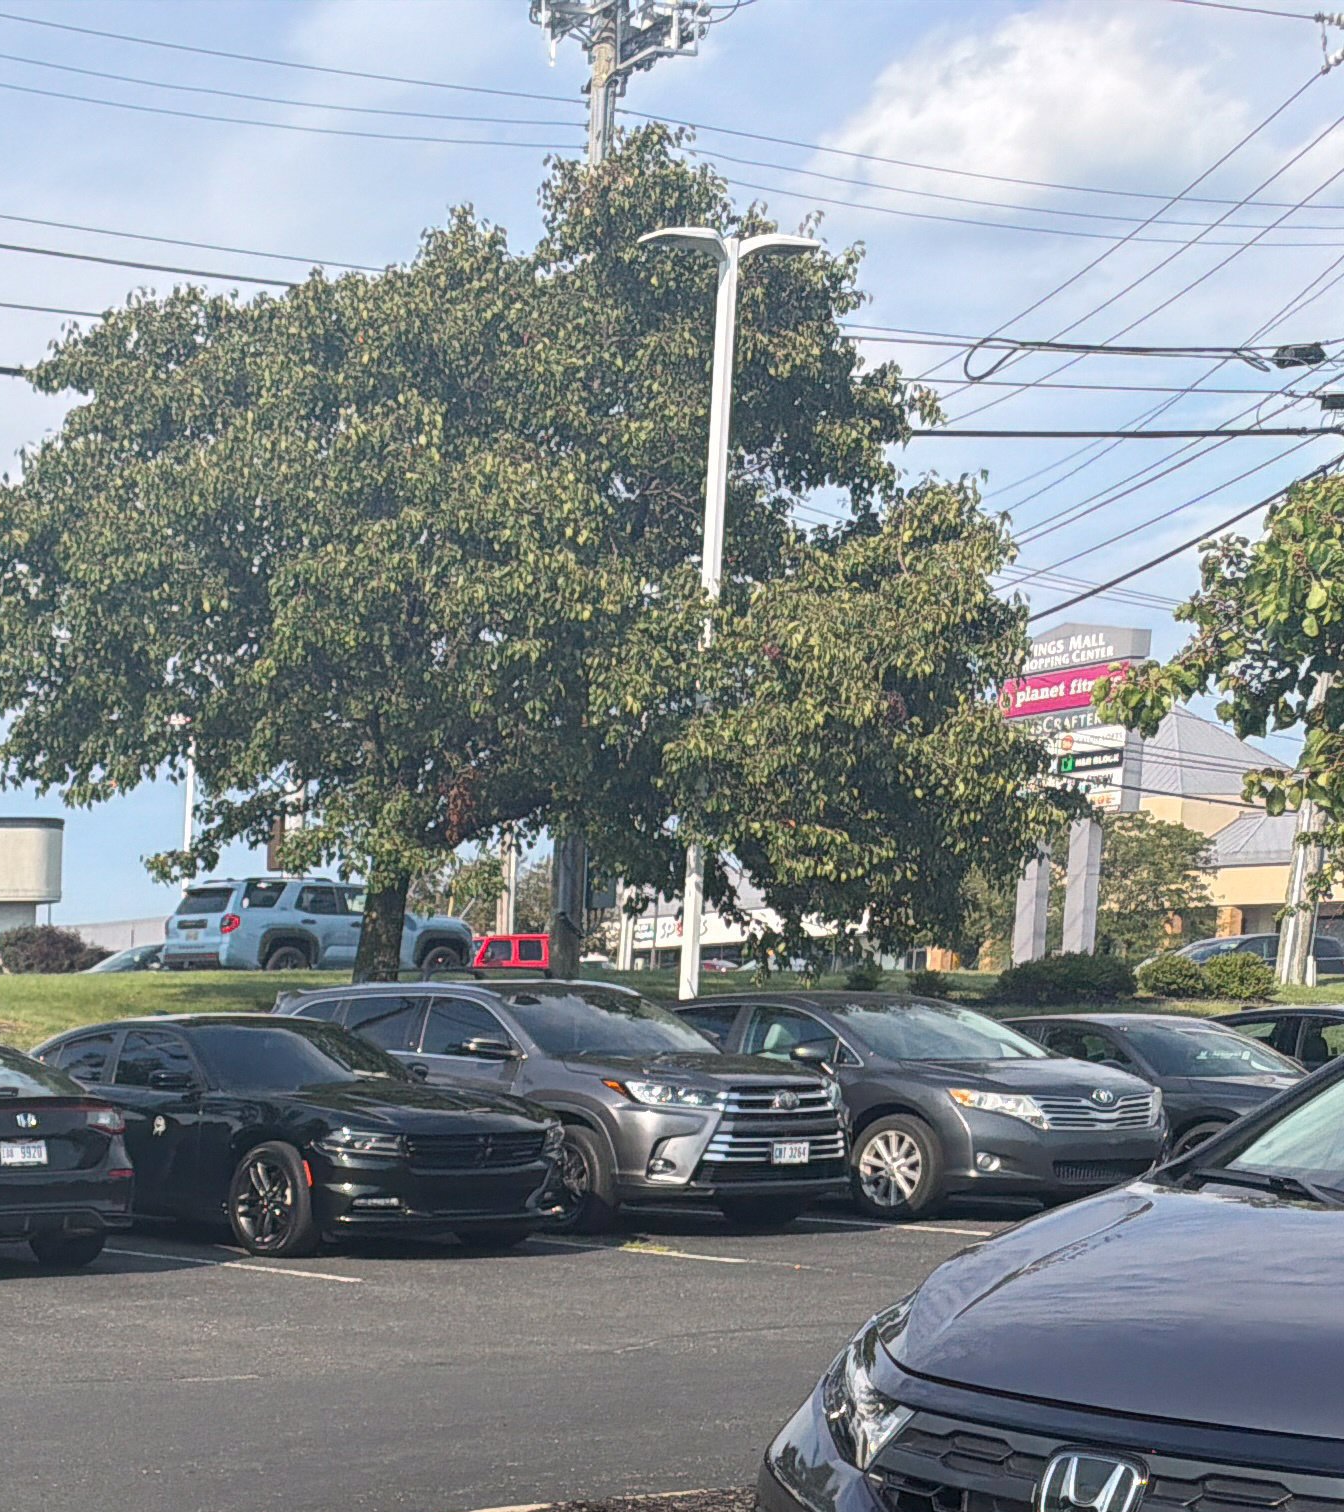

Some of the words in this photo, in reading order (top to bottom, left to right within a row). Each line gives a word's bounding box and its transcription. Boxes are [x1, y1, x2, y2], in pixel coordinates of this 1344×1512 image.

[1069, 632, 1105, 650] MALL
[1022, 653, 1070, 672] HOPPING
[1072, 645, 1114, 663] CENTER
[1015, 681, 1065, 708] planet
